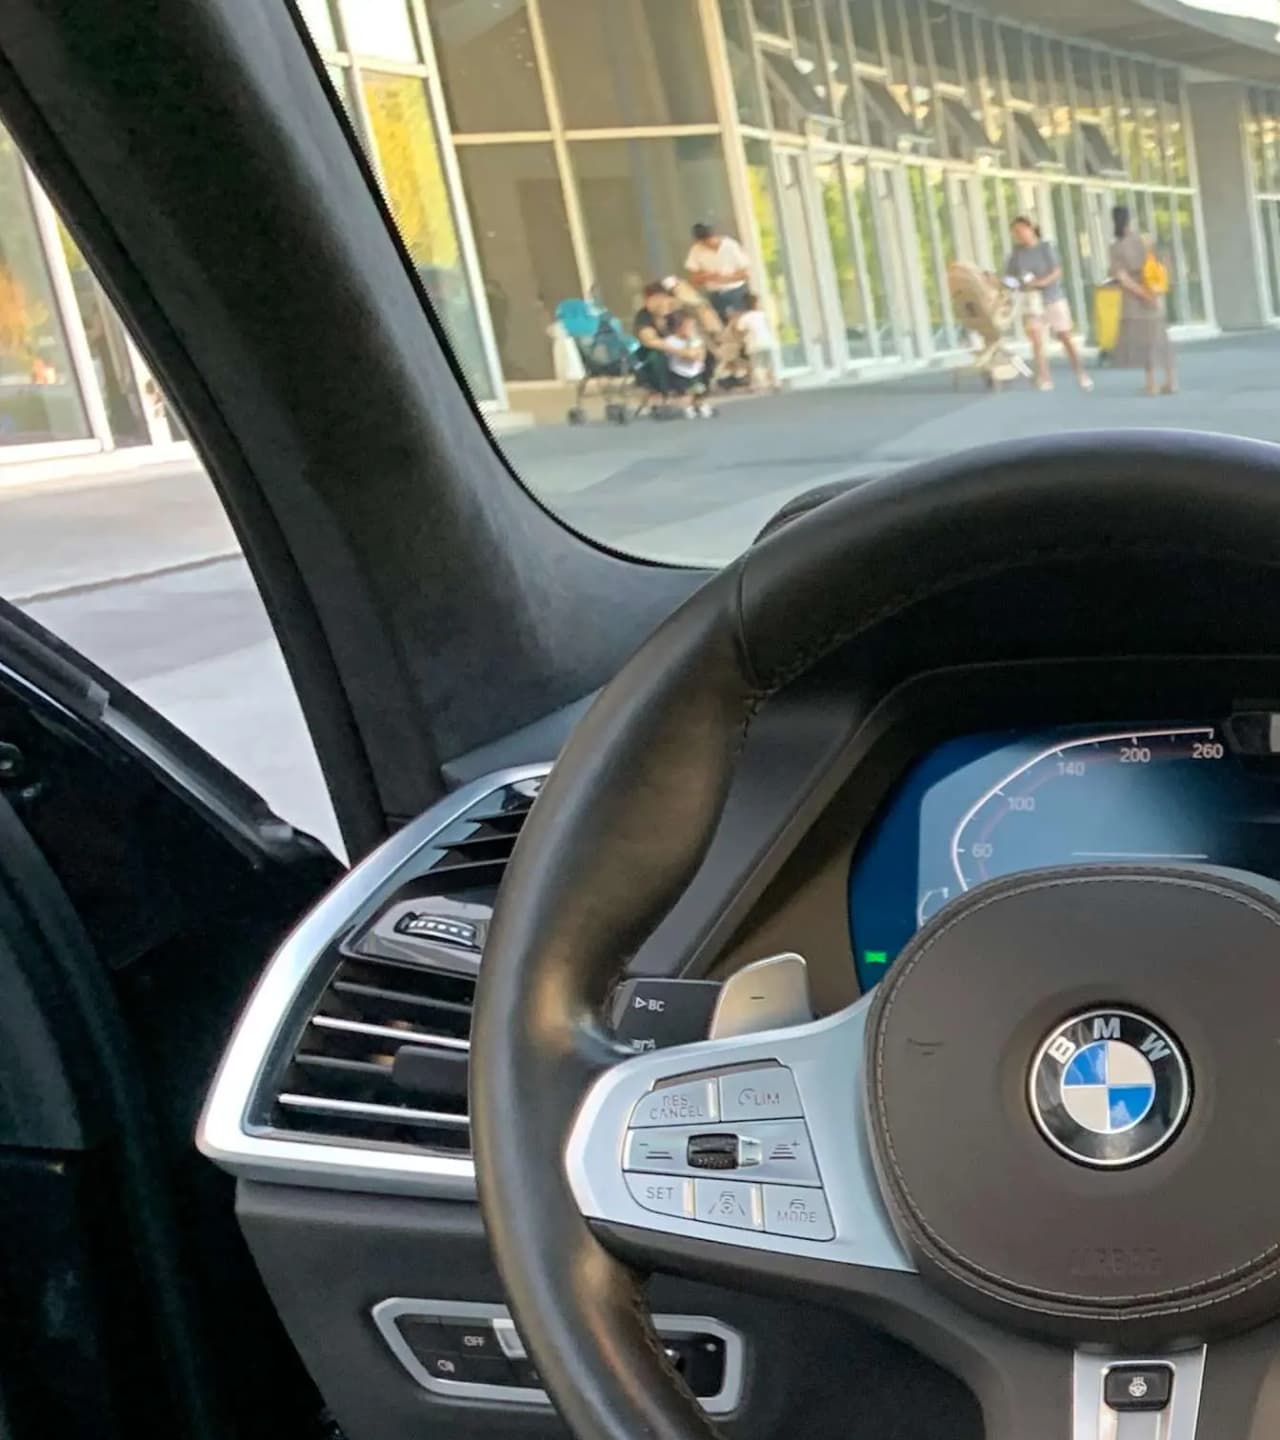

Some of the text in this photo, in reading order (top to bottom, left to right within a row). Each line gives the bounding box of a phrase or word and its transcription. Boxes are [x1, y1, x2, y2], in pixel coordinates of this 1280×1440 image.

[1120, 747, 1150, 763] 200
[1192, 743, 1223, 760] 260
[1057, 762, 1085, 776] 140
[1008, 798, 1035, 812] 100
[972, 843, 993, 858] 60
[647, 999, 665, 1012] BC
[1047, 1017, 1172, 1065] BMW
[662, 1095, 689, 1108] RES
[649, 1105, 704, 1120] CANCEL
[646, 1187, 675, 1201] SET
